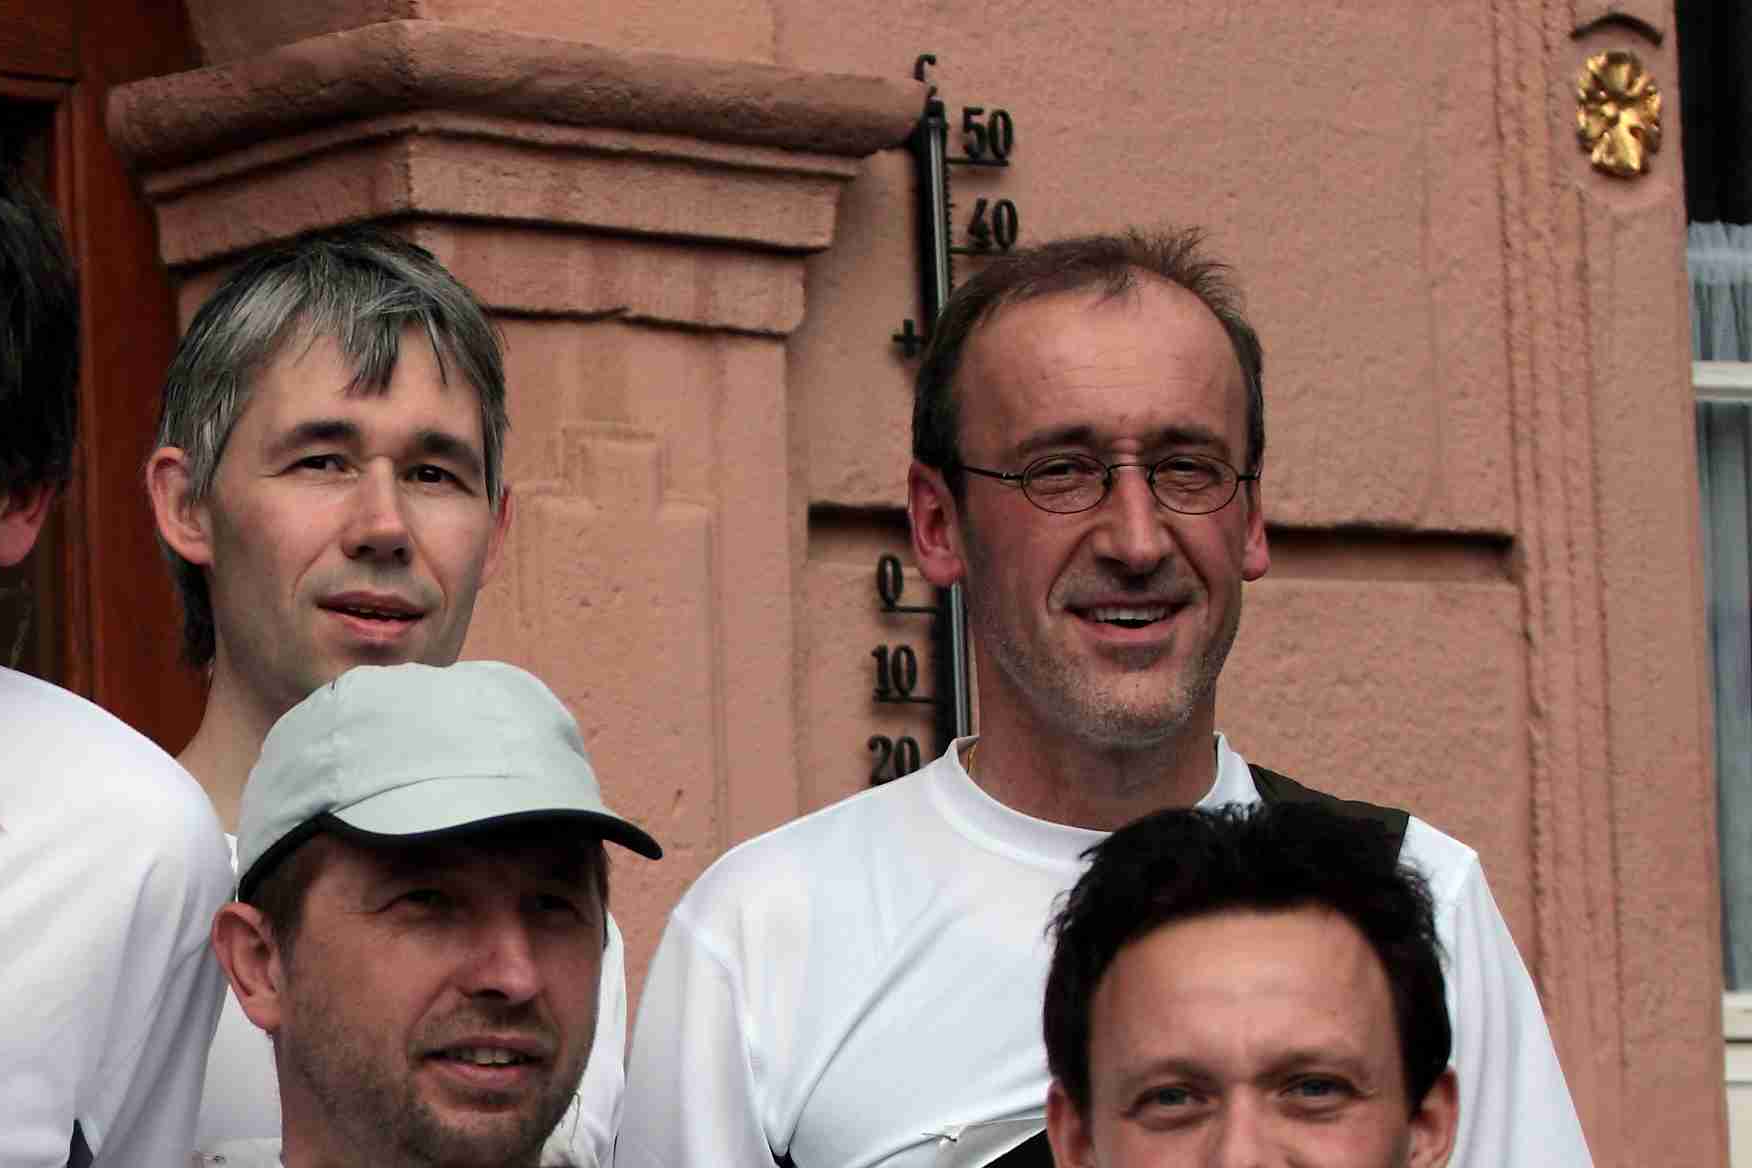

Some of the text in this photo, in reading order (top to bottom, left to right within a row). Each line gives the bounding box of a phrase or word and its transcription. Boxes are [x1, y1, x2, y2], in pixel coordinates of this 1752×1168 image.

[962, 105, 1014, 160] 50
[968, 198, 1017, 249] 40
[878, 554, 904, 608] 0
[871, 644, 917, 698] 10
[868, 734, 921, 785] 20
